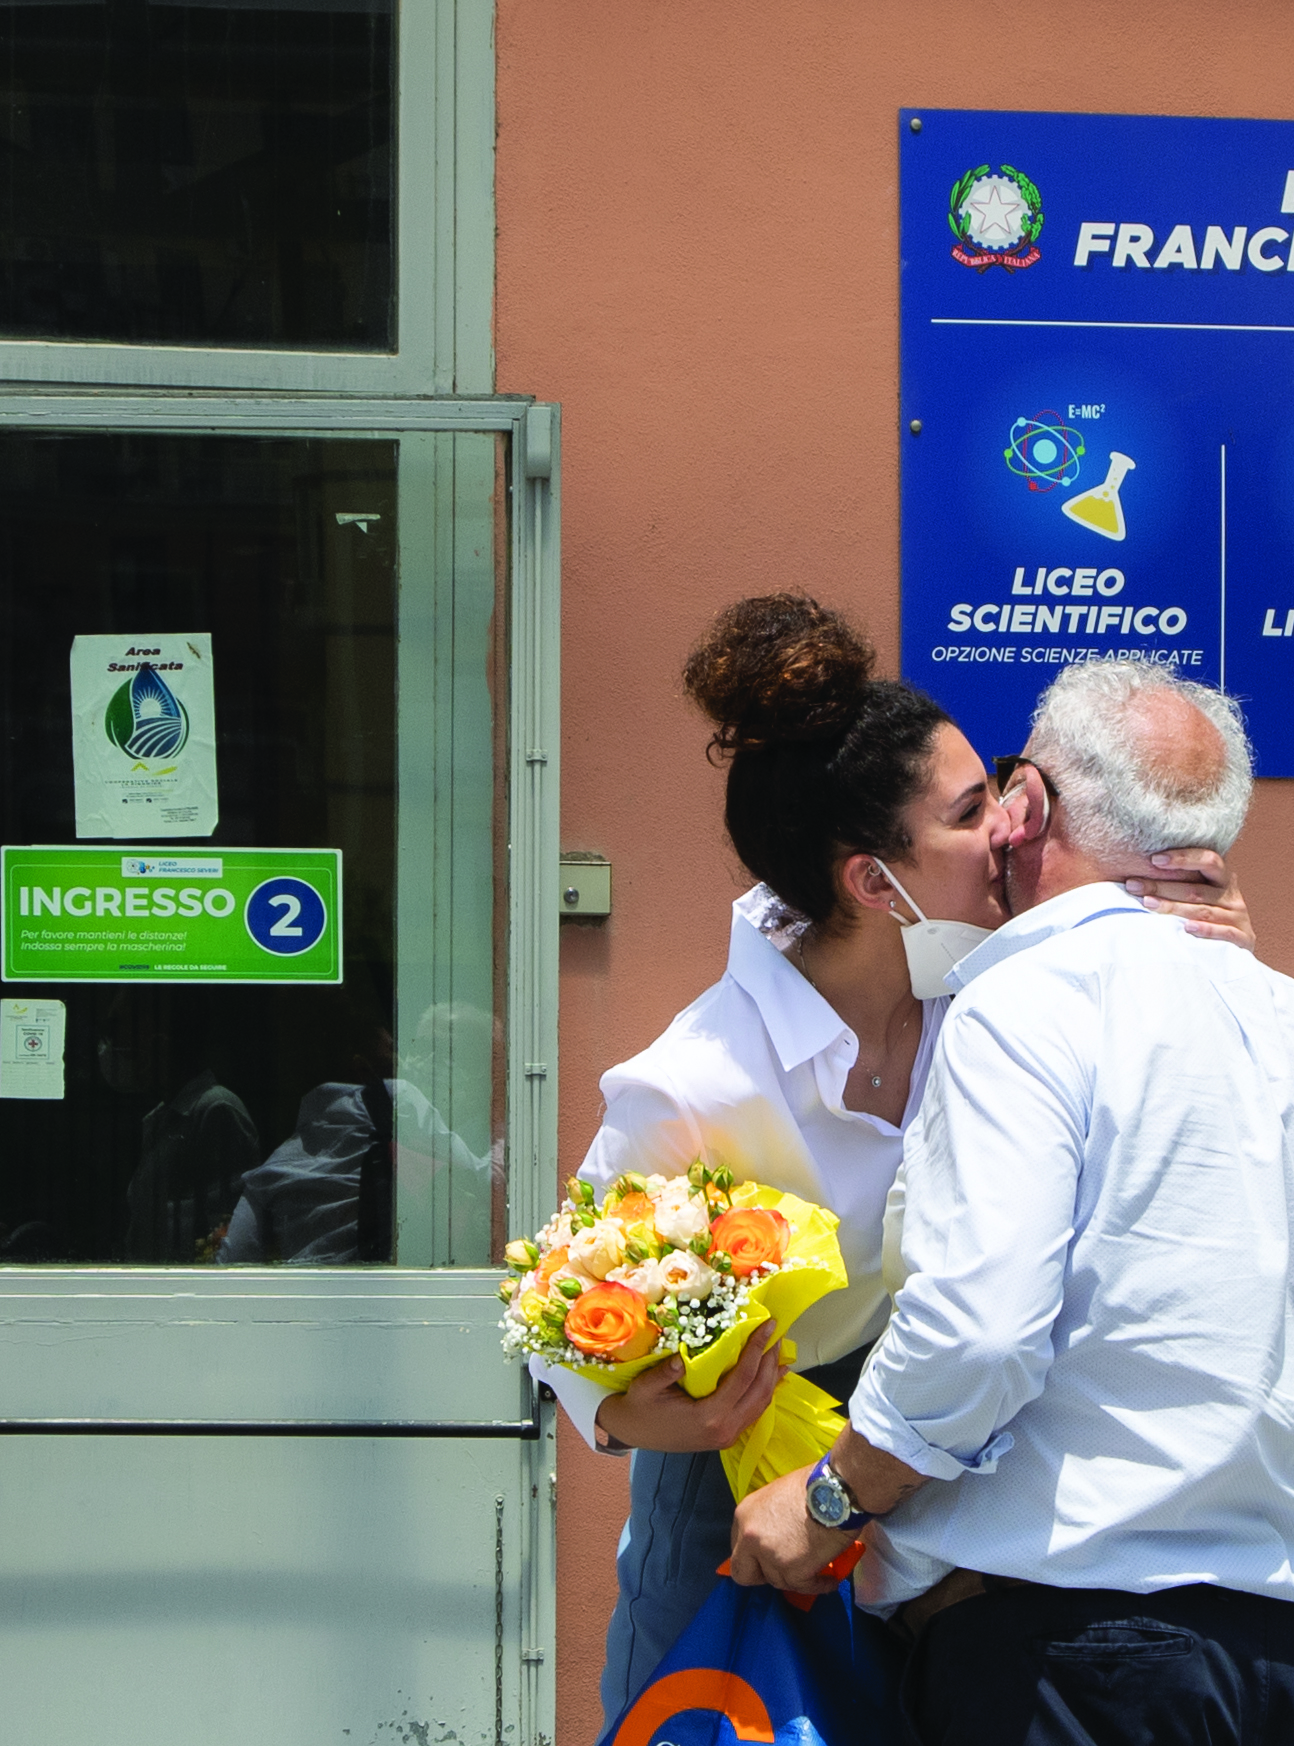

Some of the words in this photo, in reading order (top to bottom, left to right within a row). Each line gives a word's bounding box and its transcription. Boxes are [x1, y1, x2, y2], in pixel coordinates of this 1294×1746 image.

[1011, 567, 1125, 597] LICEO
[947, 603, 1188, 635] SCIENTIFICO
[125, 647, 161, 656] Area
[931, 646, 1016, 662] OPZIONE
[1020, 647, 1099, 664] SCIENZE
[19, 886, 236, 918] INGRESSO
[268, 894, 303, 937] 2
[20, 930, 39, 939] Per
[41, 930, 75, 940] favore
[76, 931, 126, 940] mantieni
[127, 931, 137, 940] le
[138, 931, 188, 941] distanze!
[20, 941, 62, 950] Indossa
[64, 943, 105, 952] sempre
[106, 942, 118, 951] la
[119, 942, 187, 952] mascherina!
